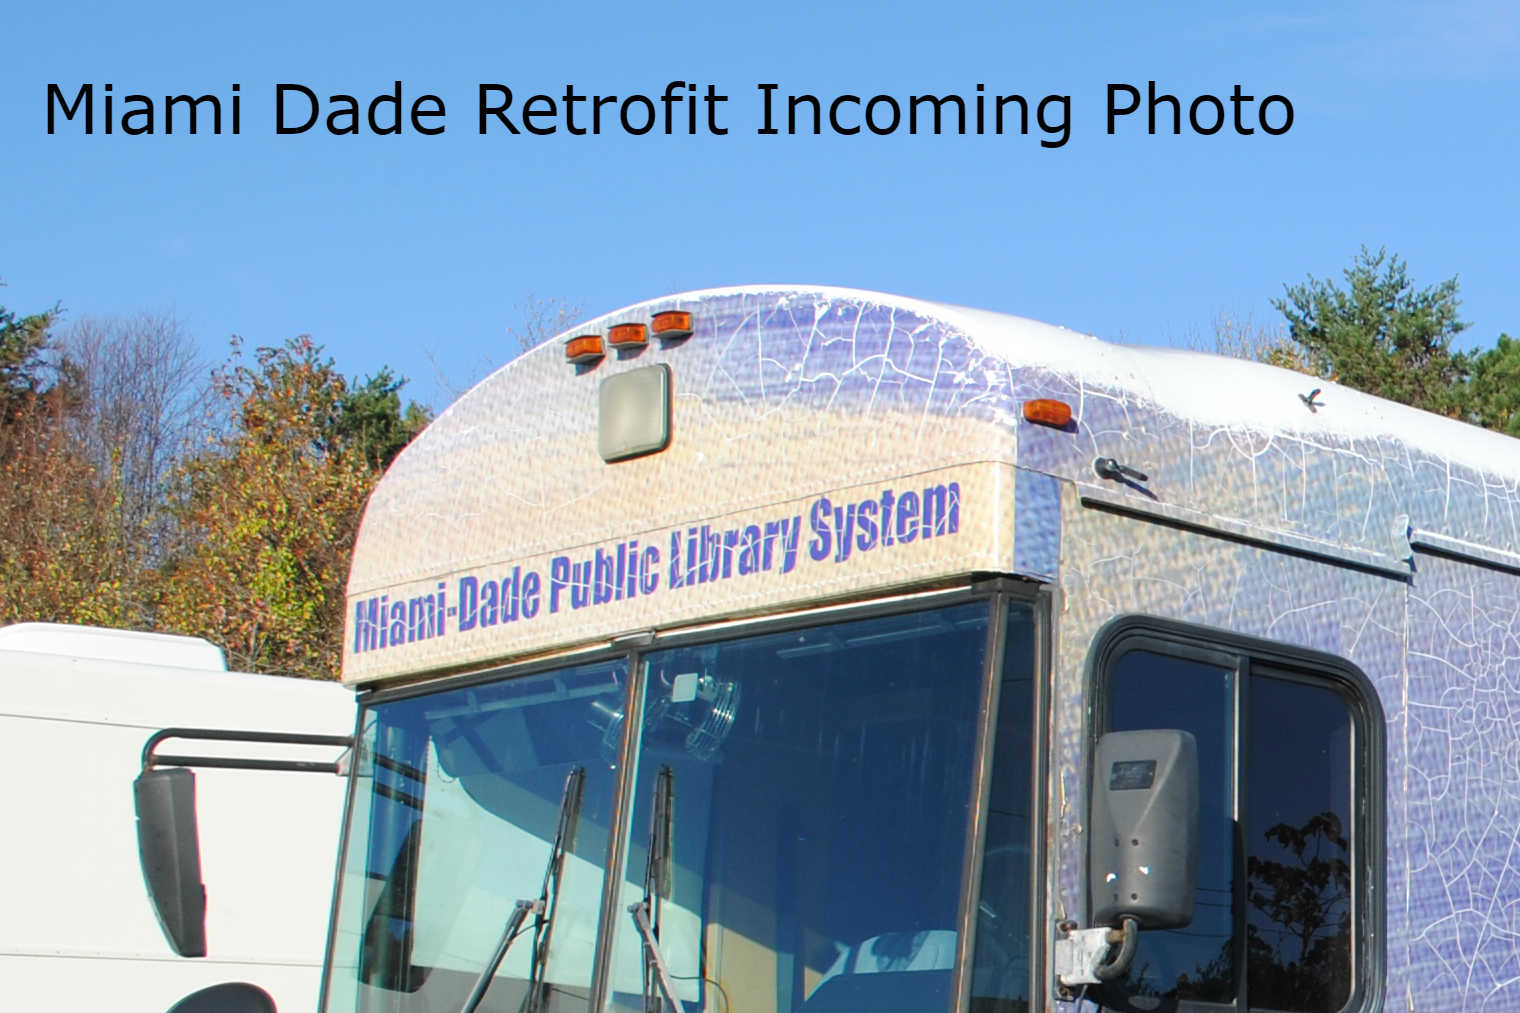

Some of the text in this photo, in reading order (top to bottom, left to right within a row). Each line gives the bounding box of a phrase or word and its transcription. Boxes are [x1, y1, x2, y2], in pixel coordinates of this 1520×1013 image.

[353, 481, 961, 654] Miami-Dade Public Library System
